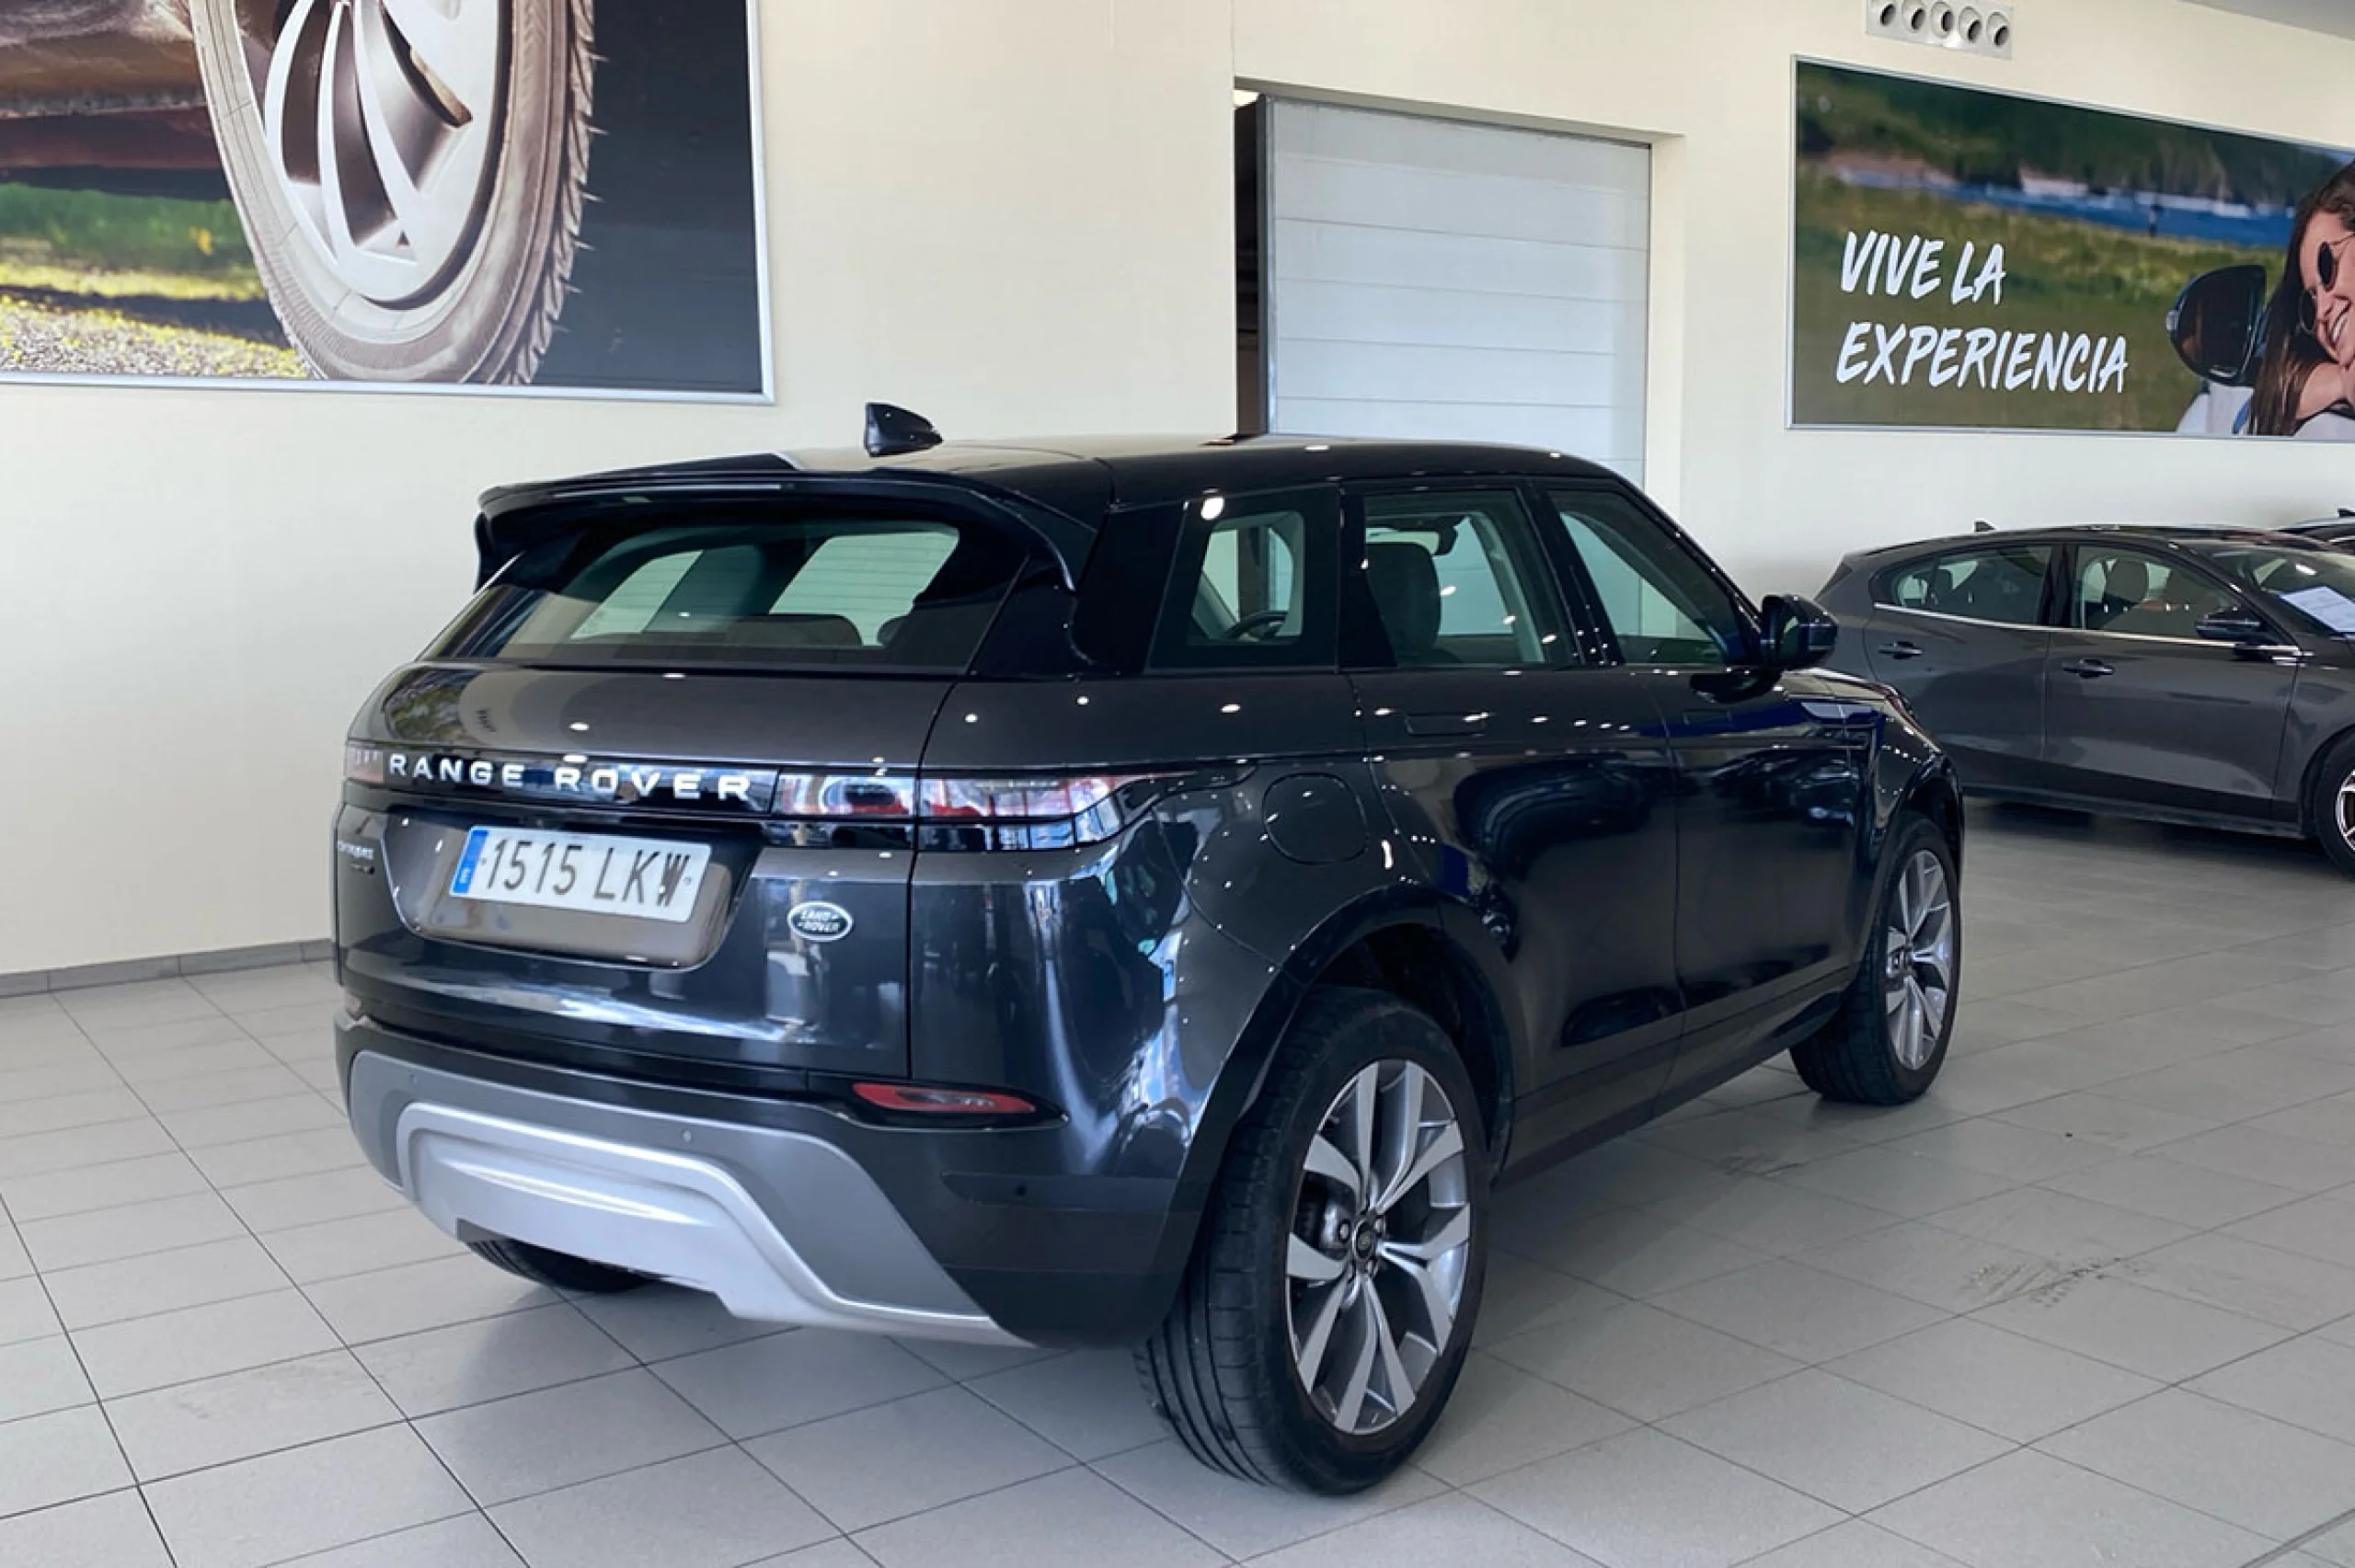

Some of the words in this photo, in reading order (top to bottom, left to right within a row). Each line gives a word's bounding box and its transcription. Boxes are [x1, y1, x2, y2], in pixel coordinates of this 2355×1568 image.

[1841, 230, 1944, 299] VIVE
[1951, 240, 2005, 304] LA
[1836, 321, 2128, 393] EXPERIENCIA
[388, 753, 525, 788] RANGE
[554, 768, 750, 801] ROVER
[487, 838, 582, 895] 1515
[593, 847, 690, 907] LKW
